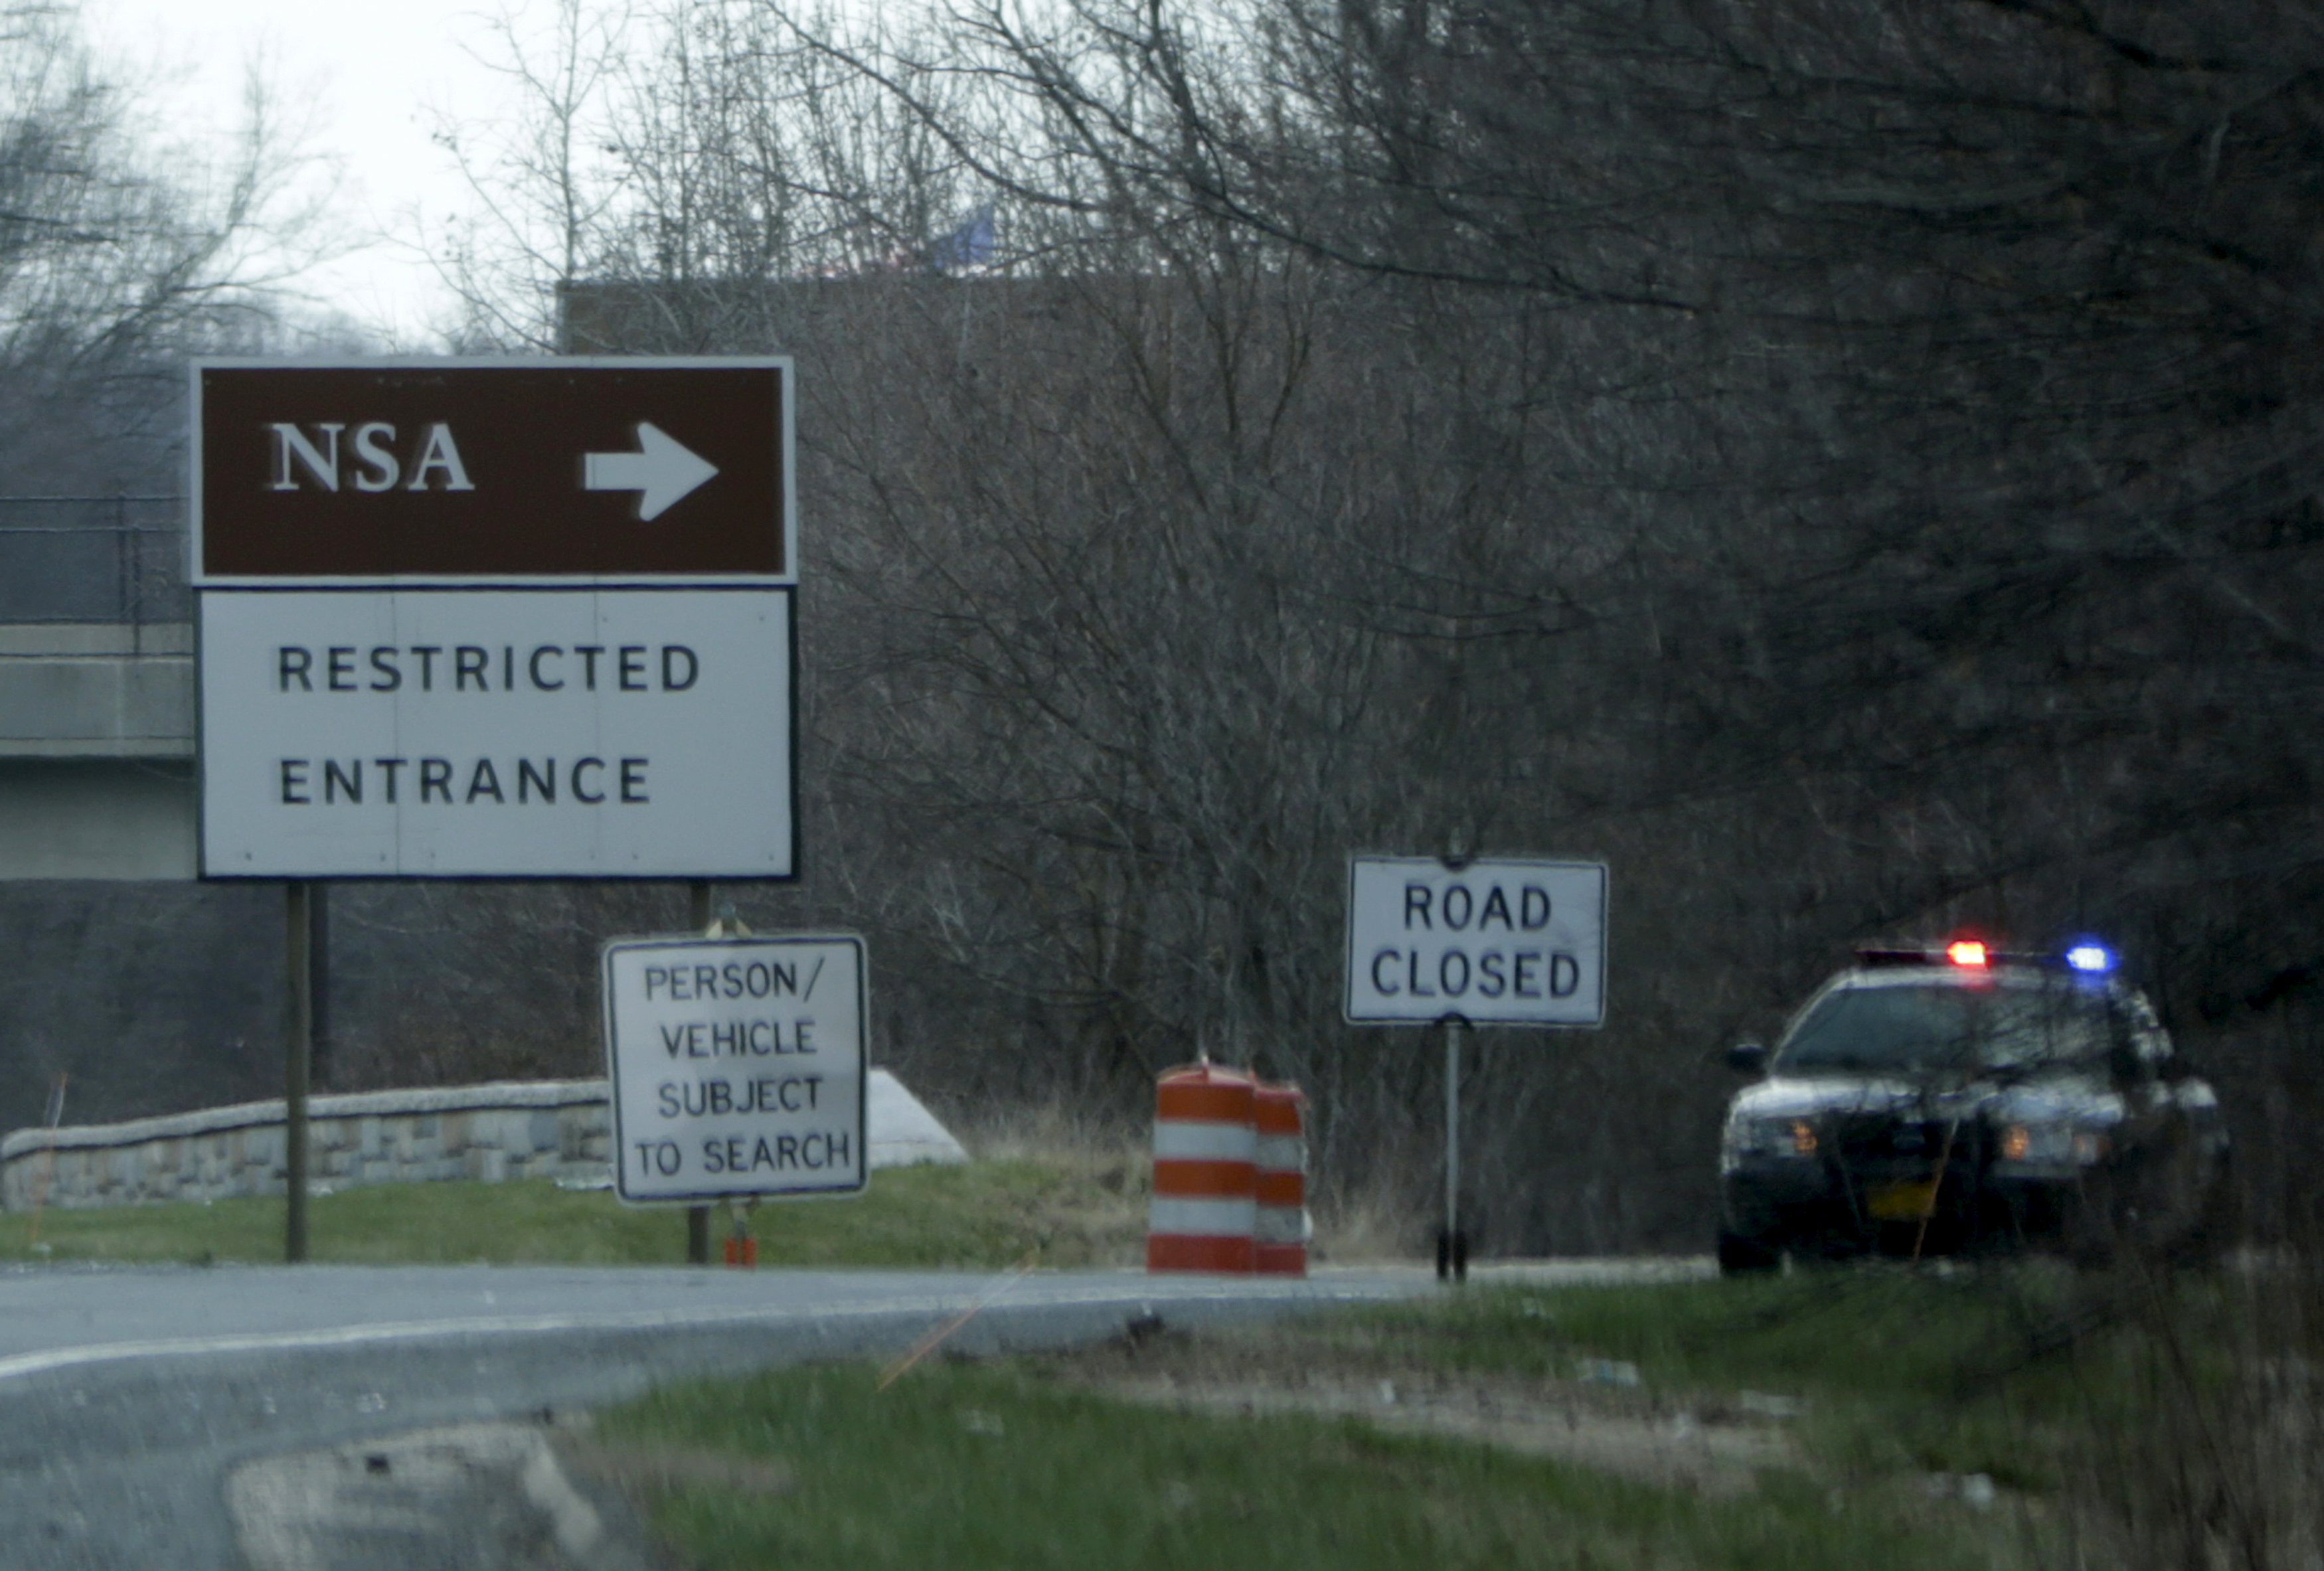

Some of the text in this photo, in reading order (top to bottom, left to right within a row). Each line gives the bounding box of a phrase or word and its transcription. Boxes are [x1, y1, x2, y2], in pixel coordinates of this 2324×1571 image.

[270, 422, 475, 492] NSA
[278, 645, 701, 693] RESTRICTED
[280, 757, 651, 805] ENTRANCE
[1403, 884, 1552, 930] ROAD
[644, 957, 825, 1003] PERSON/
[1371, 949, 1580, 999] CLOSED
[661, 1020, 818, 1060] VEHICLE
[658, 1077, 823, 1118] SUBJECT
[634, 1133, 850, 1177] TO SEARCH
